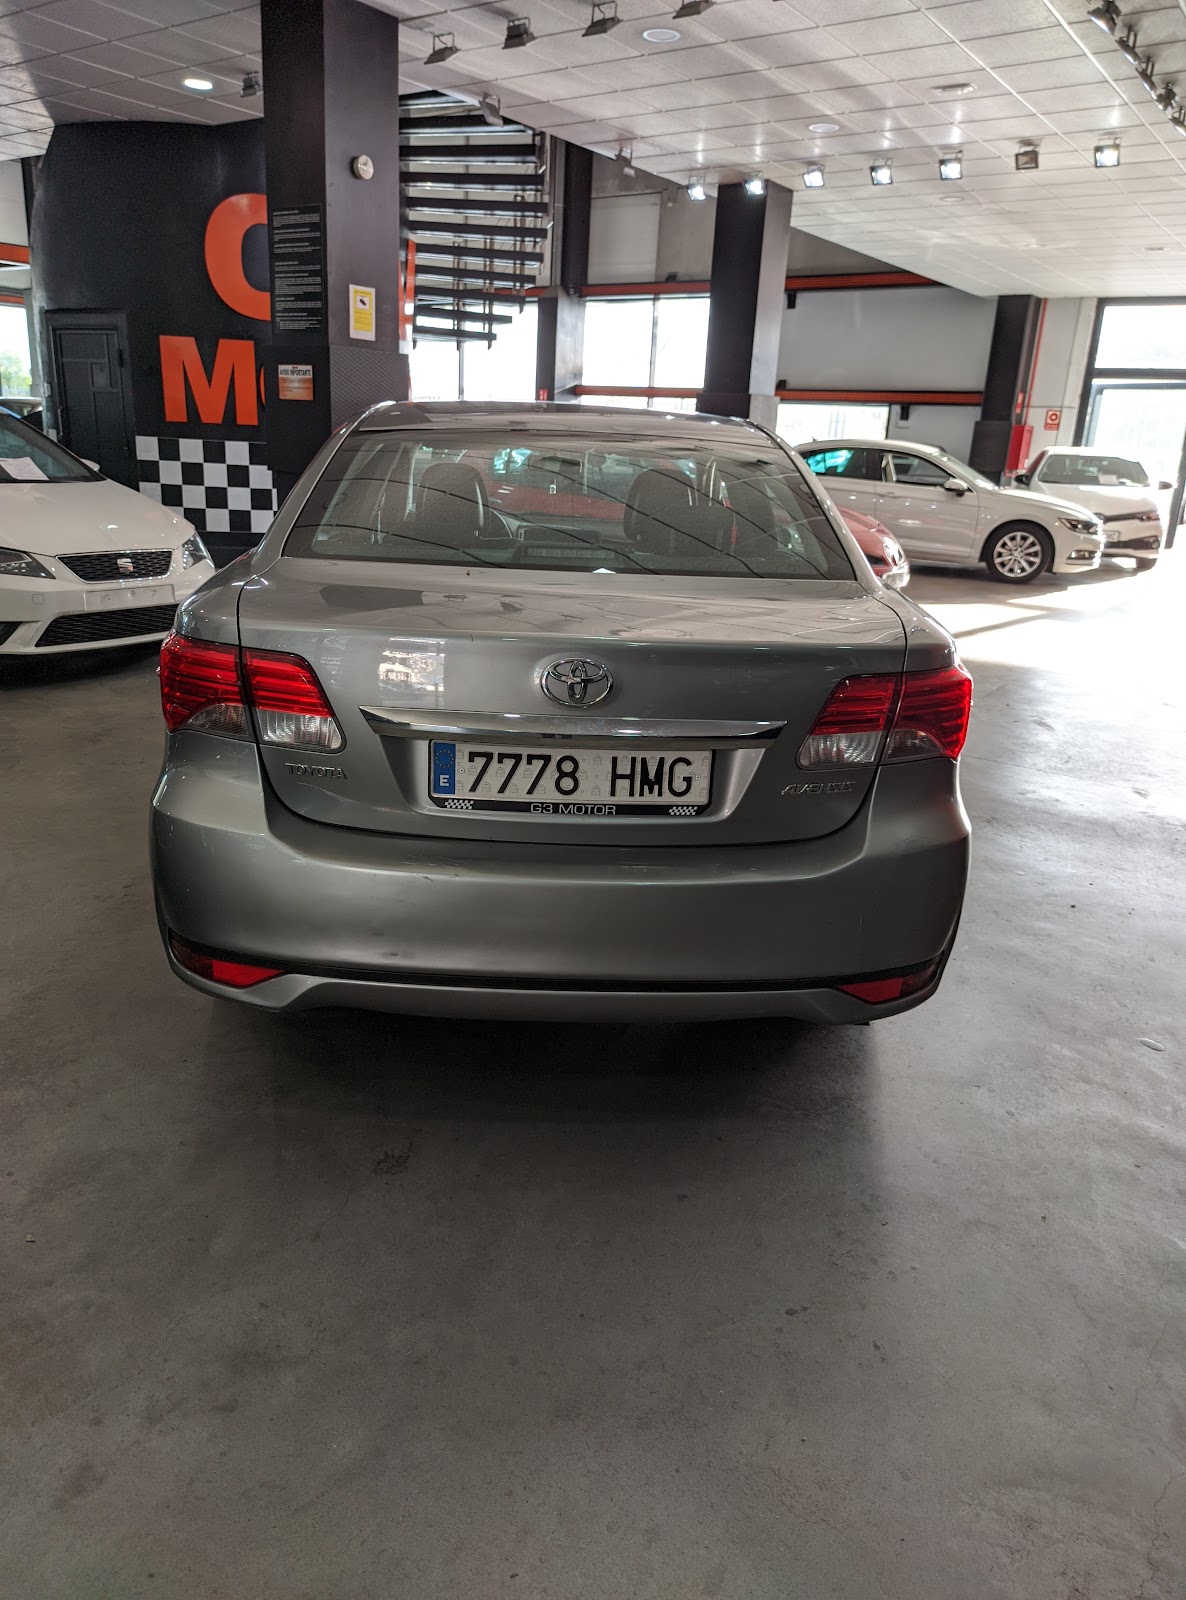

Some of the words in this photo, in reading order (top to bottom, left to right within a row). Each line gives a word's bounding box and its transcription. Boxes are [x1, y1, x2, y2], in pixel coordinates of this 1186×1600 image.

[285, 762, 348, 780] TOYOTA
[468, 751, 579, 796] 7778
[610, 756, 692, 798] HMG
[439, 774, 450, 787] E
[530, 803, 554, 814] G3
[559, 804, 616, 816] MOTOR
